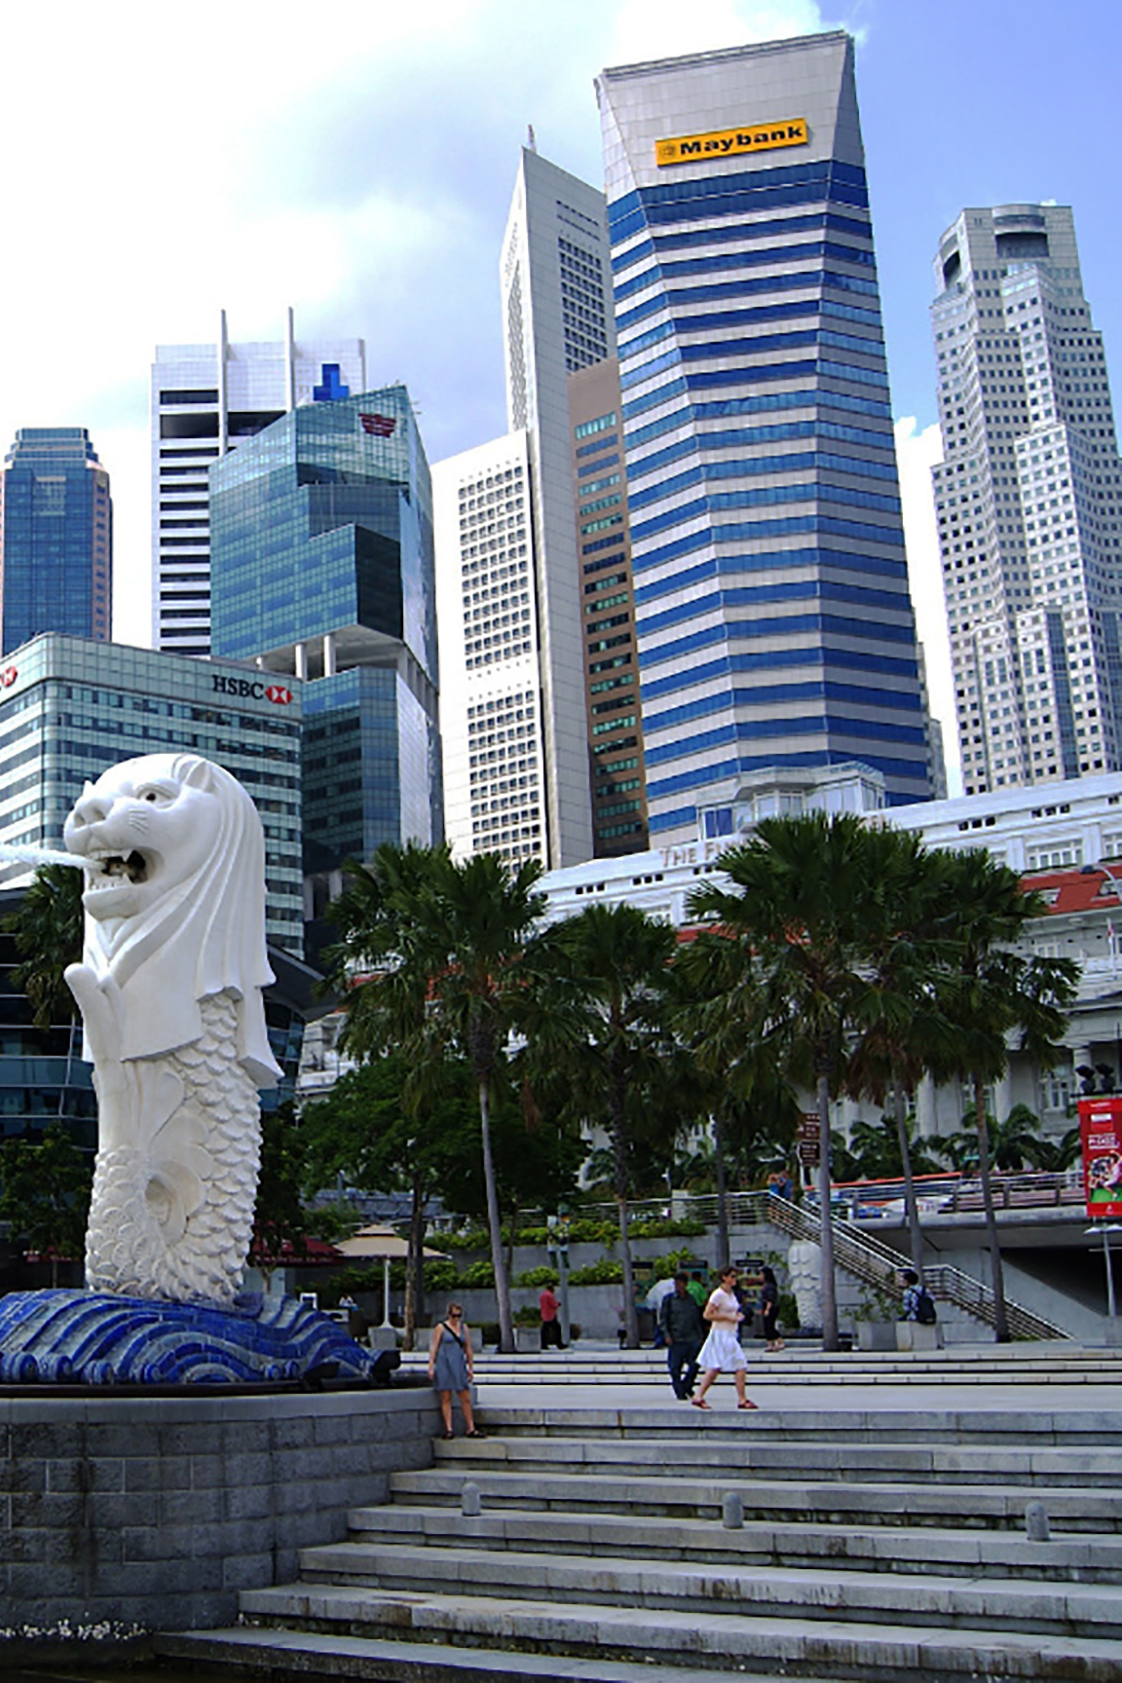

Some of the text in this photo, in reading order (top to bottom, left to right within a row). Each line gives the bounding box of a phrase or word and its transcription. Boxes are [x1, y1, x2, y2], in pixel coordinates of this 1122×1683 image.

[680, 126, 803, 155] Maybank
[212, 674, 264, 700] HSBC
[659, 847, 697, 868] THE
